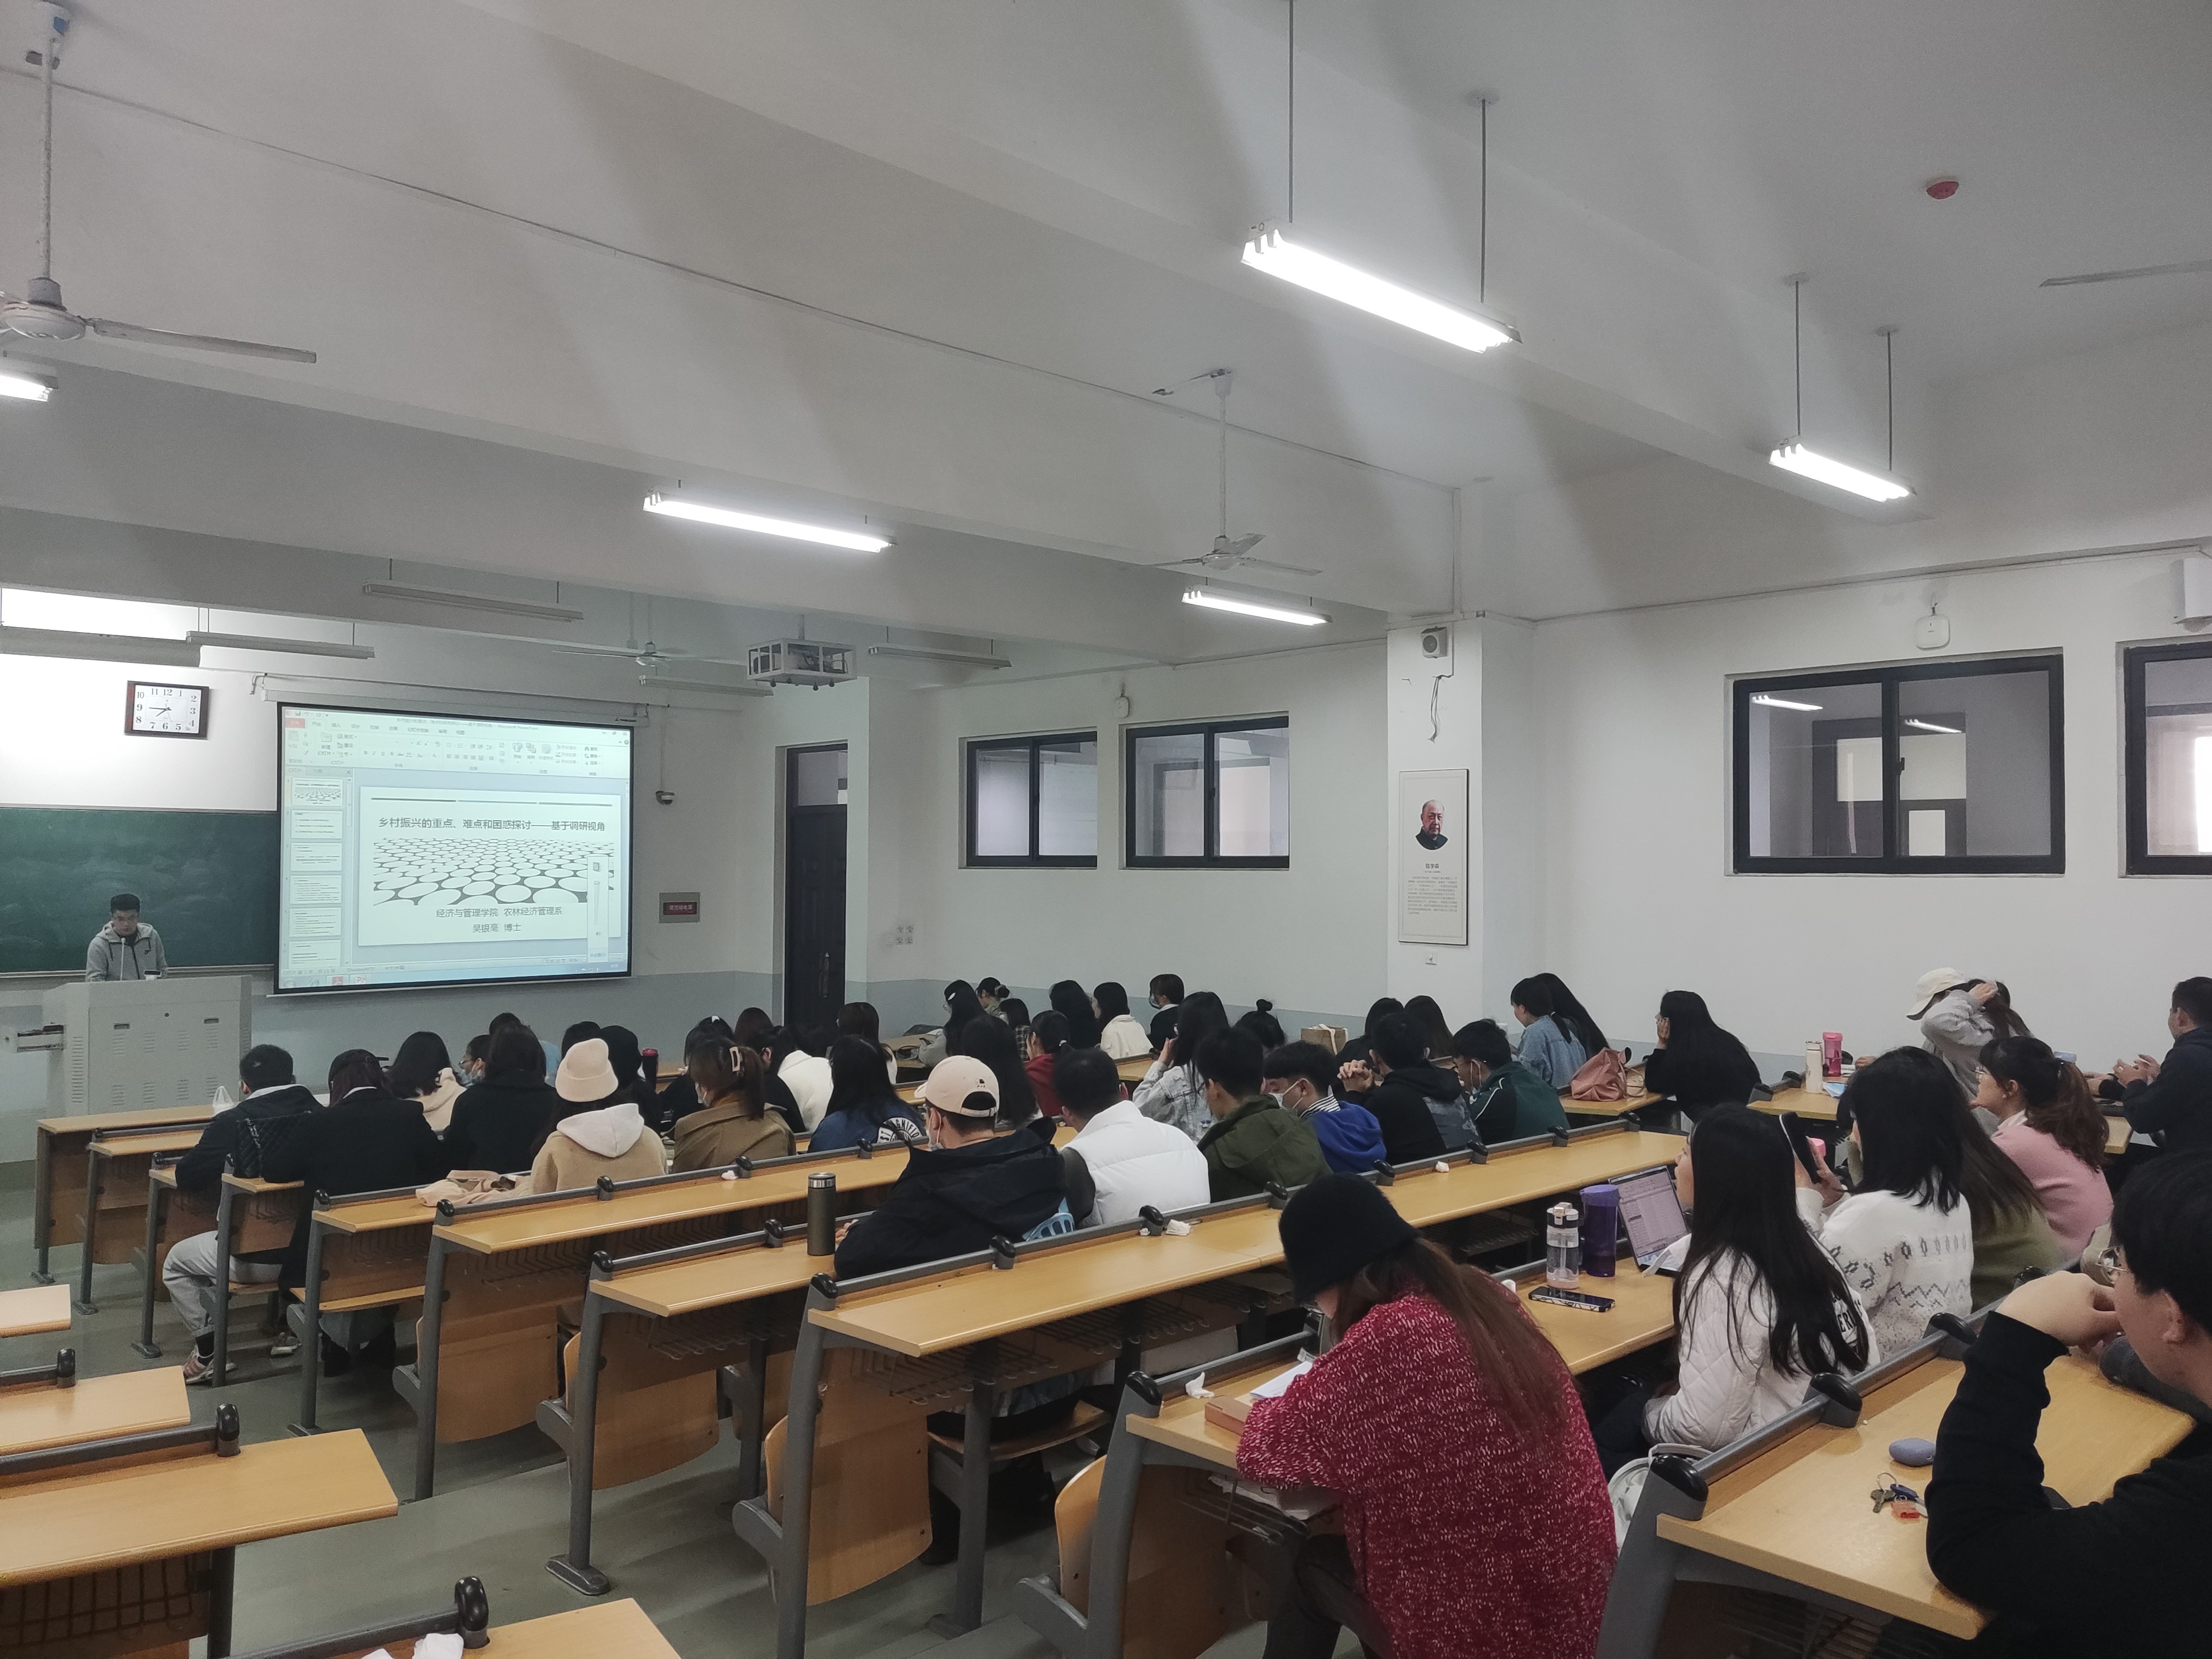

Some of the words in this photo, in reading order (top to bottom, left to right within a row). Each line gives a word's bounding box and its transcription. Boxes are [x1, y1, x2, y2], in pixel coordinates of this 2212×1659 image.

[436, 908, 498, 918] 经济与管理学院
[503, 906, 562, 916] 农林经济管理系
[504, 923, 522, 932] 博士
